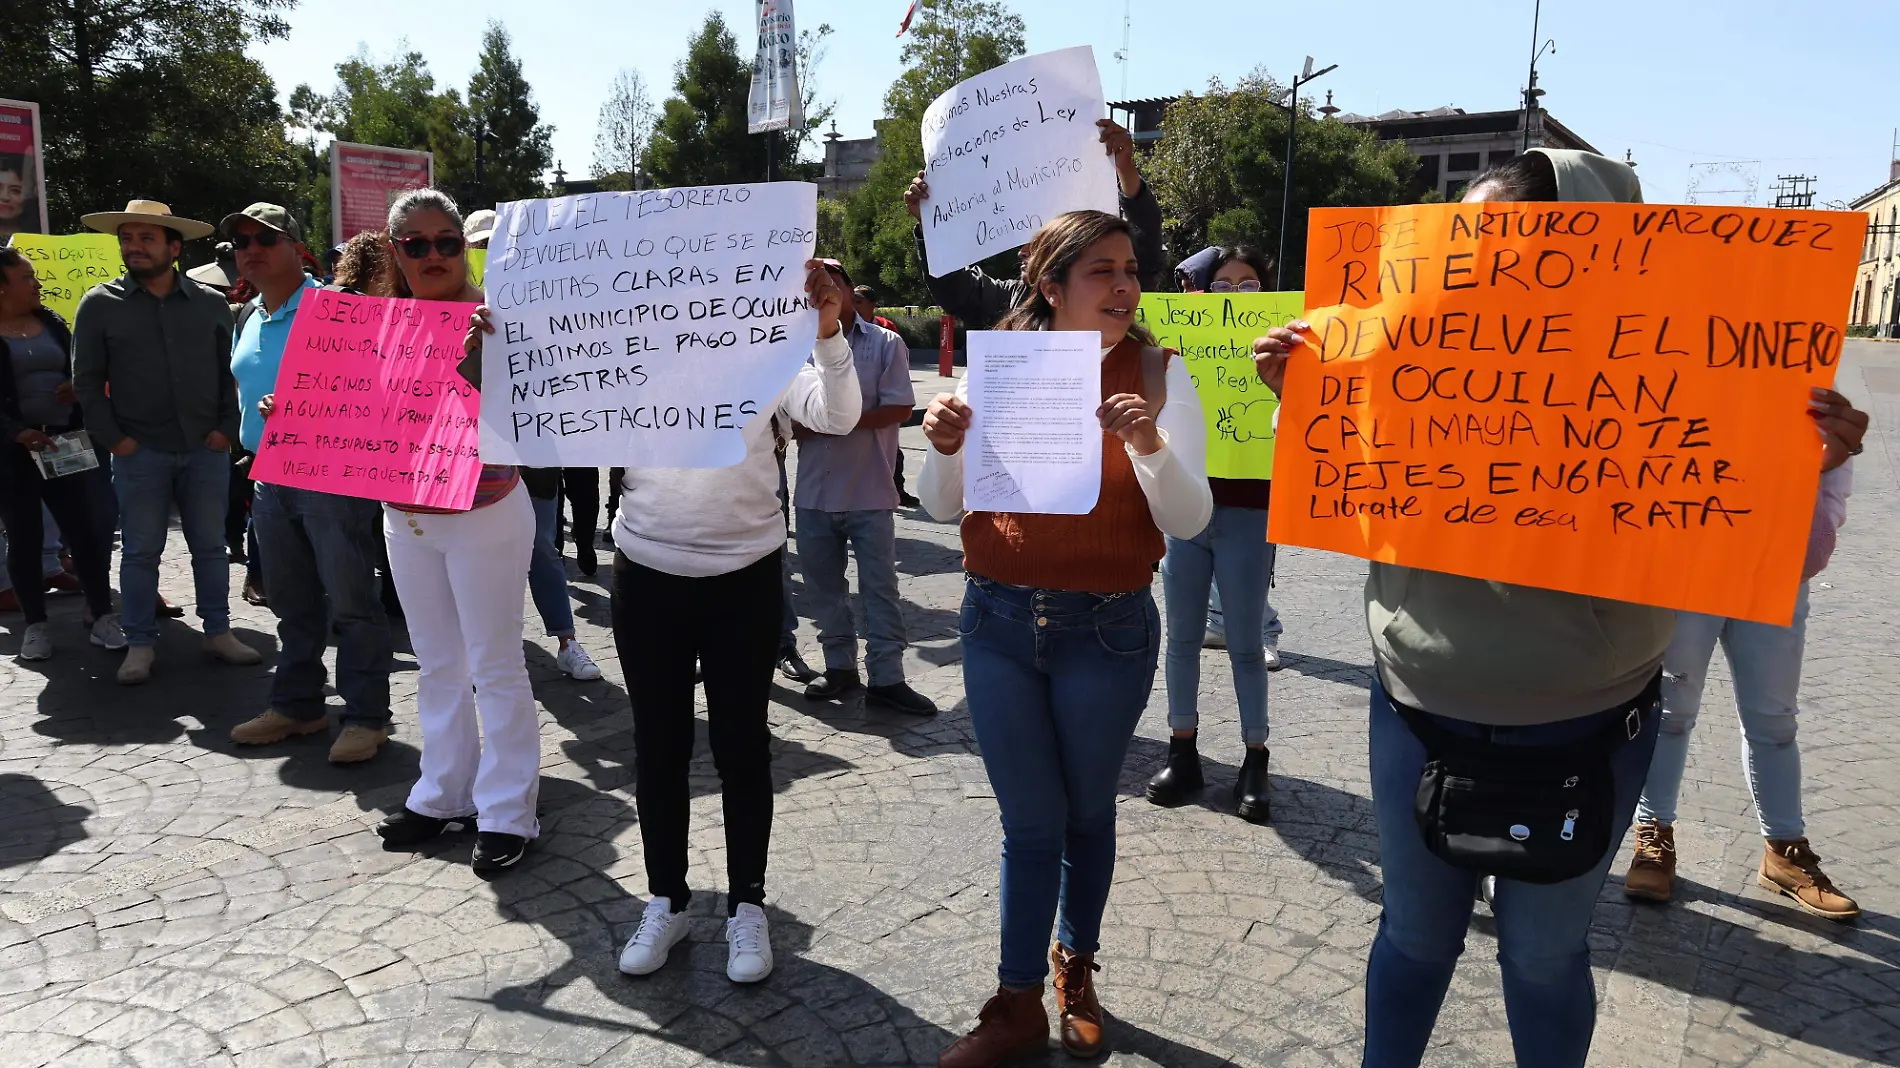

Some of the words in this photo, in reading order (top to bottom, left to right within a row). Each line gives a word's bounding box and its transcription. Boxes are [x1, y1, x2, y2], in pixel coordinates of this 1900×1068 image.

[976, 78, 1038, 107] Nuestras
[1012, 117, 1029, 132] de
[1037, 101, 1076, 124] Ley
[507, 203, 561, 243] QUE
[575, 197, 607, 230] EL
[613, 187, 751, 219] TESORERO
[933, 192, 986, 228] Auditoria
[992, 180, 1001, 196] al
[992, 205, 1004, 215] de
[503, 238, 612, 272] DEVUELVA
[624, 238, 654, 258] LO
[664, 232, 718, 257] QUE
[727, 234, 755, 250] SE
[767, 227, 814, 249] ROBO
[976, 214, 1042, 246] Ocuilan
[1324, 218, 1420, 263] JOSE
[1450, 210, 1600, 242] ARTURO
[1633, 207, 1834, 251] VAZQUEZ
[11, 244, 108, 262] RESIDENTE
[497, 274, 599, 310] CUENTAS
[612, 265, 719, 293] CLARAS
[735, 264, 785, 284] EN
[316, 299, 422, 327] SEGURDAD
[504, 321, 533, 344] EL
[549, 303, 679, 336] MUNICIPIO
[688, 299, 726, 321] DE
[1157, 297, 1214, 327] Jesus
[306, 335, 387, 360] MUNICIPAL
[508, 341, 613, 379] EXIJIMOS
[625, 335, 659, 356] EL
[675, 329, 737, 352] PAGO
[749, 325, 788, 344] DE
[1320, 312, 1573, 364] DEVUELVE
[1608, 313, 1690, 360] EL
[1706, 314, 1841, 374] DINERO
[293, 371, 373, 393] EXIGIMOS
[387, 379, 473, 399] NUESTRO
[511, 365, 649, 405] NUESTRAS
[1321, 374, 1366, 406] DE
[1392, 363, 1678, 413] OCUILAN
[510, 399, 758, 443] PRESTACIONES
[1305, 410, 1540, 454] CALIMAYA
[1563, 413, 1623, 450] NO
[1638, 416, 1712, 450] TE
[315, 434, 399, 454] PRESUPUESTO
[283, 460, 330, 477] VIENE
[342, 464, 430, 485] ETIQUETADO
[1314, 459, 1466, 493] DEJES
[1444, 496, 1498, 524] de
[1514, 506, 1578, 532] esa
[1610, 495, 1753, 535] RATA
